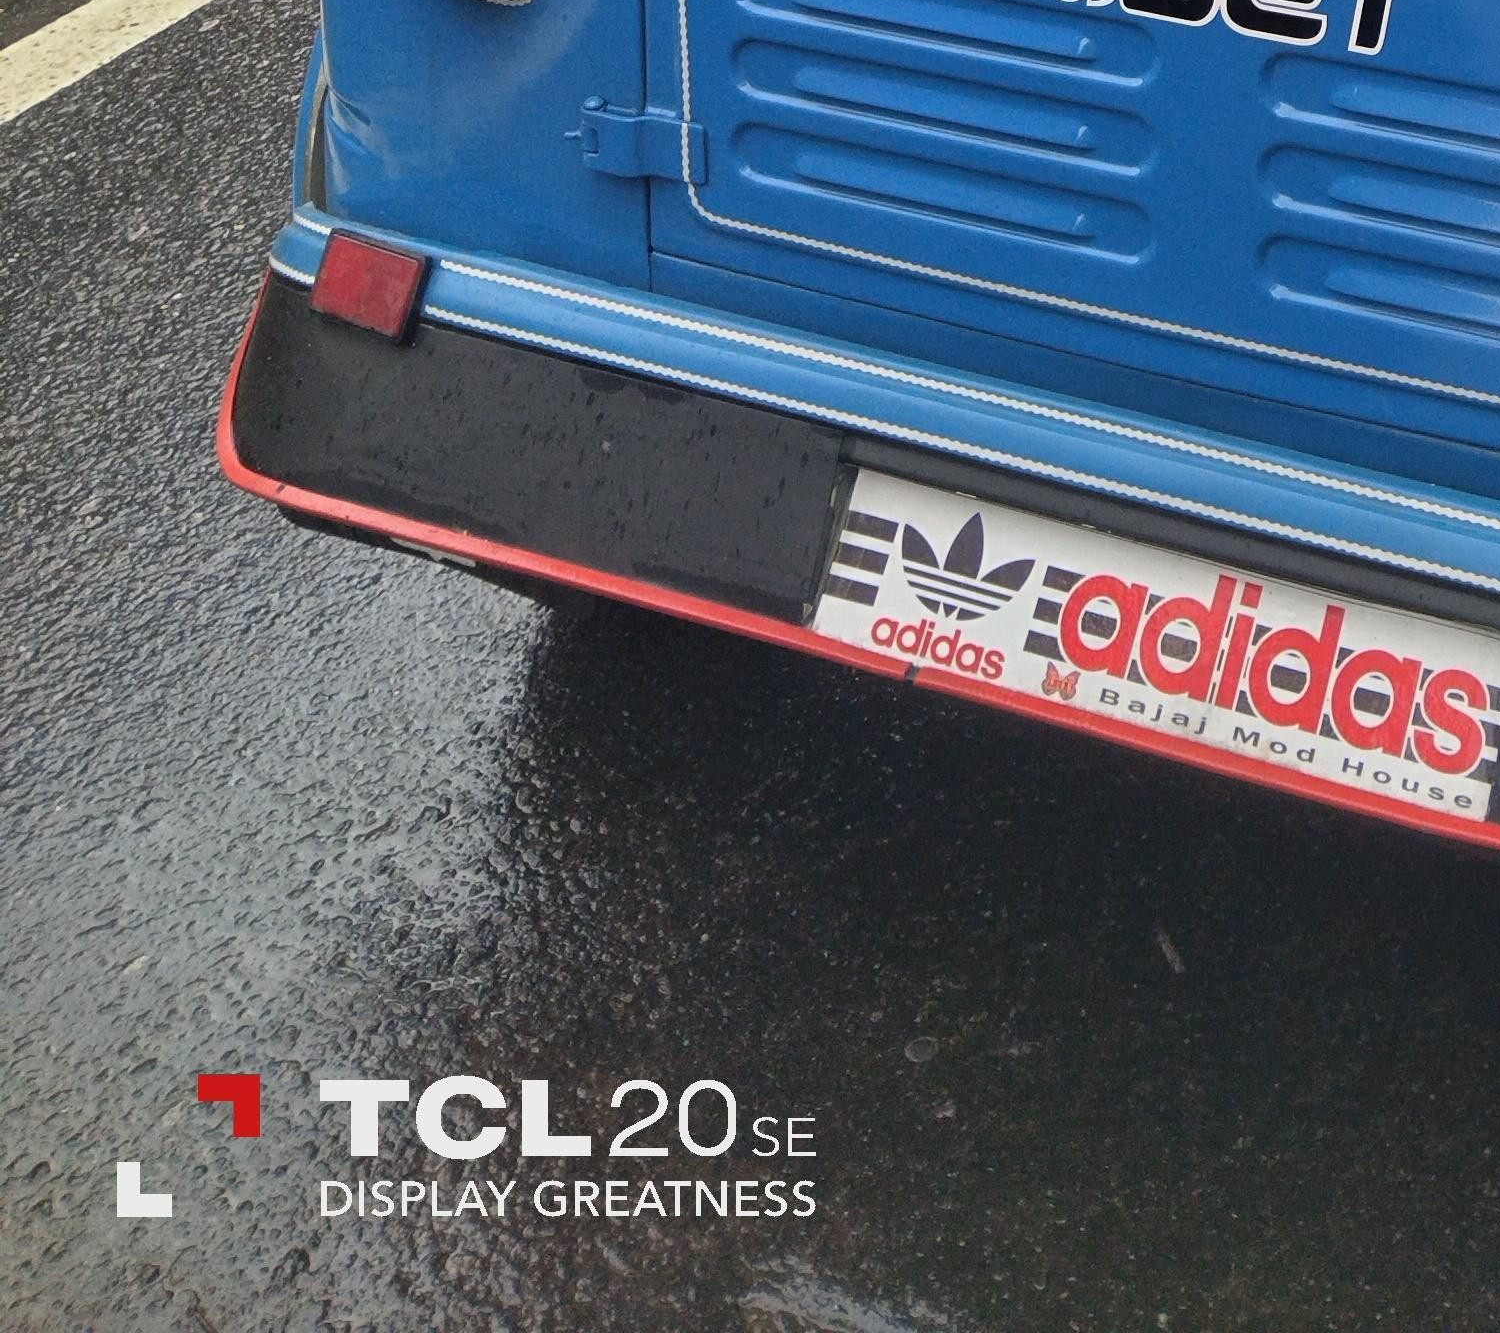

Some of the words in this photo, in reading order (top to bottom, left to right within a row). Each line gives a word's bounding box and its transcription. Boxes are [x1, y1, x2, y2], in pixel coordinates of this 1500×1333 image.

[870, 616, 1006, 680] adidas
[1058, 574, 1492, 777] adidas
[1099, 687, 1208, 737] Bajaj
[1231, 726, 1318, 763] Mod
[1341, 757, 1476, 810] House
